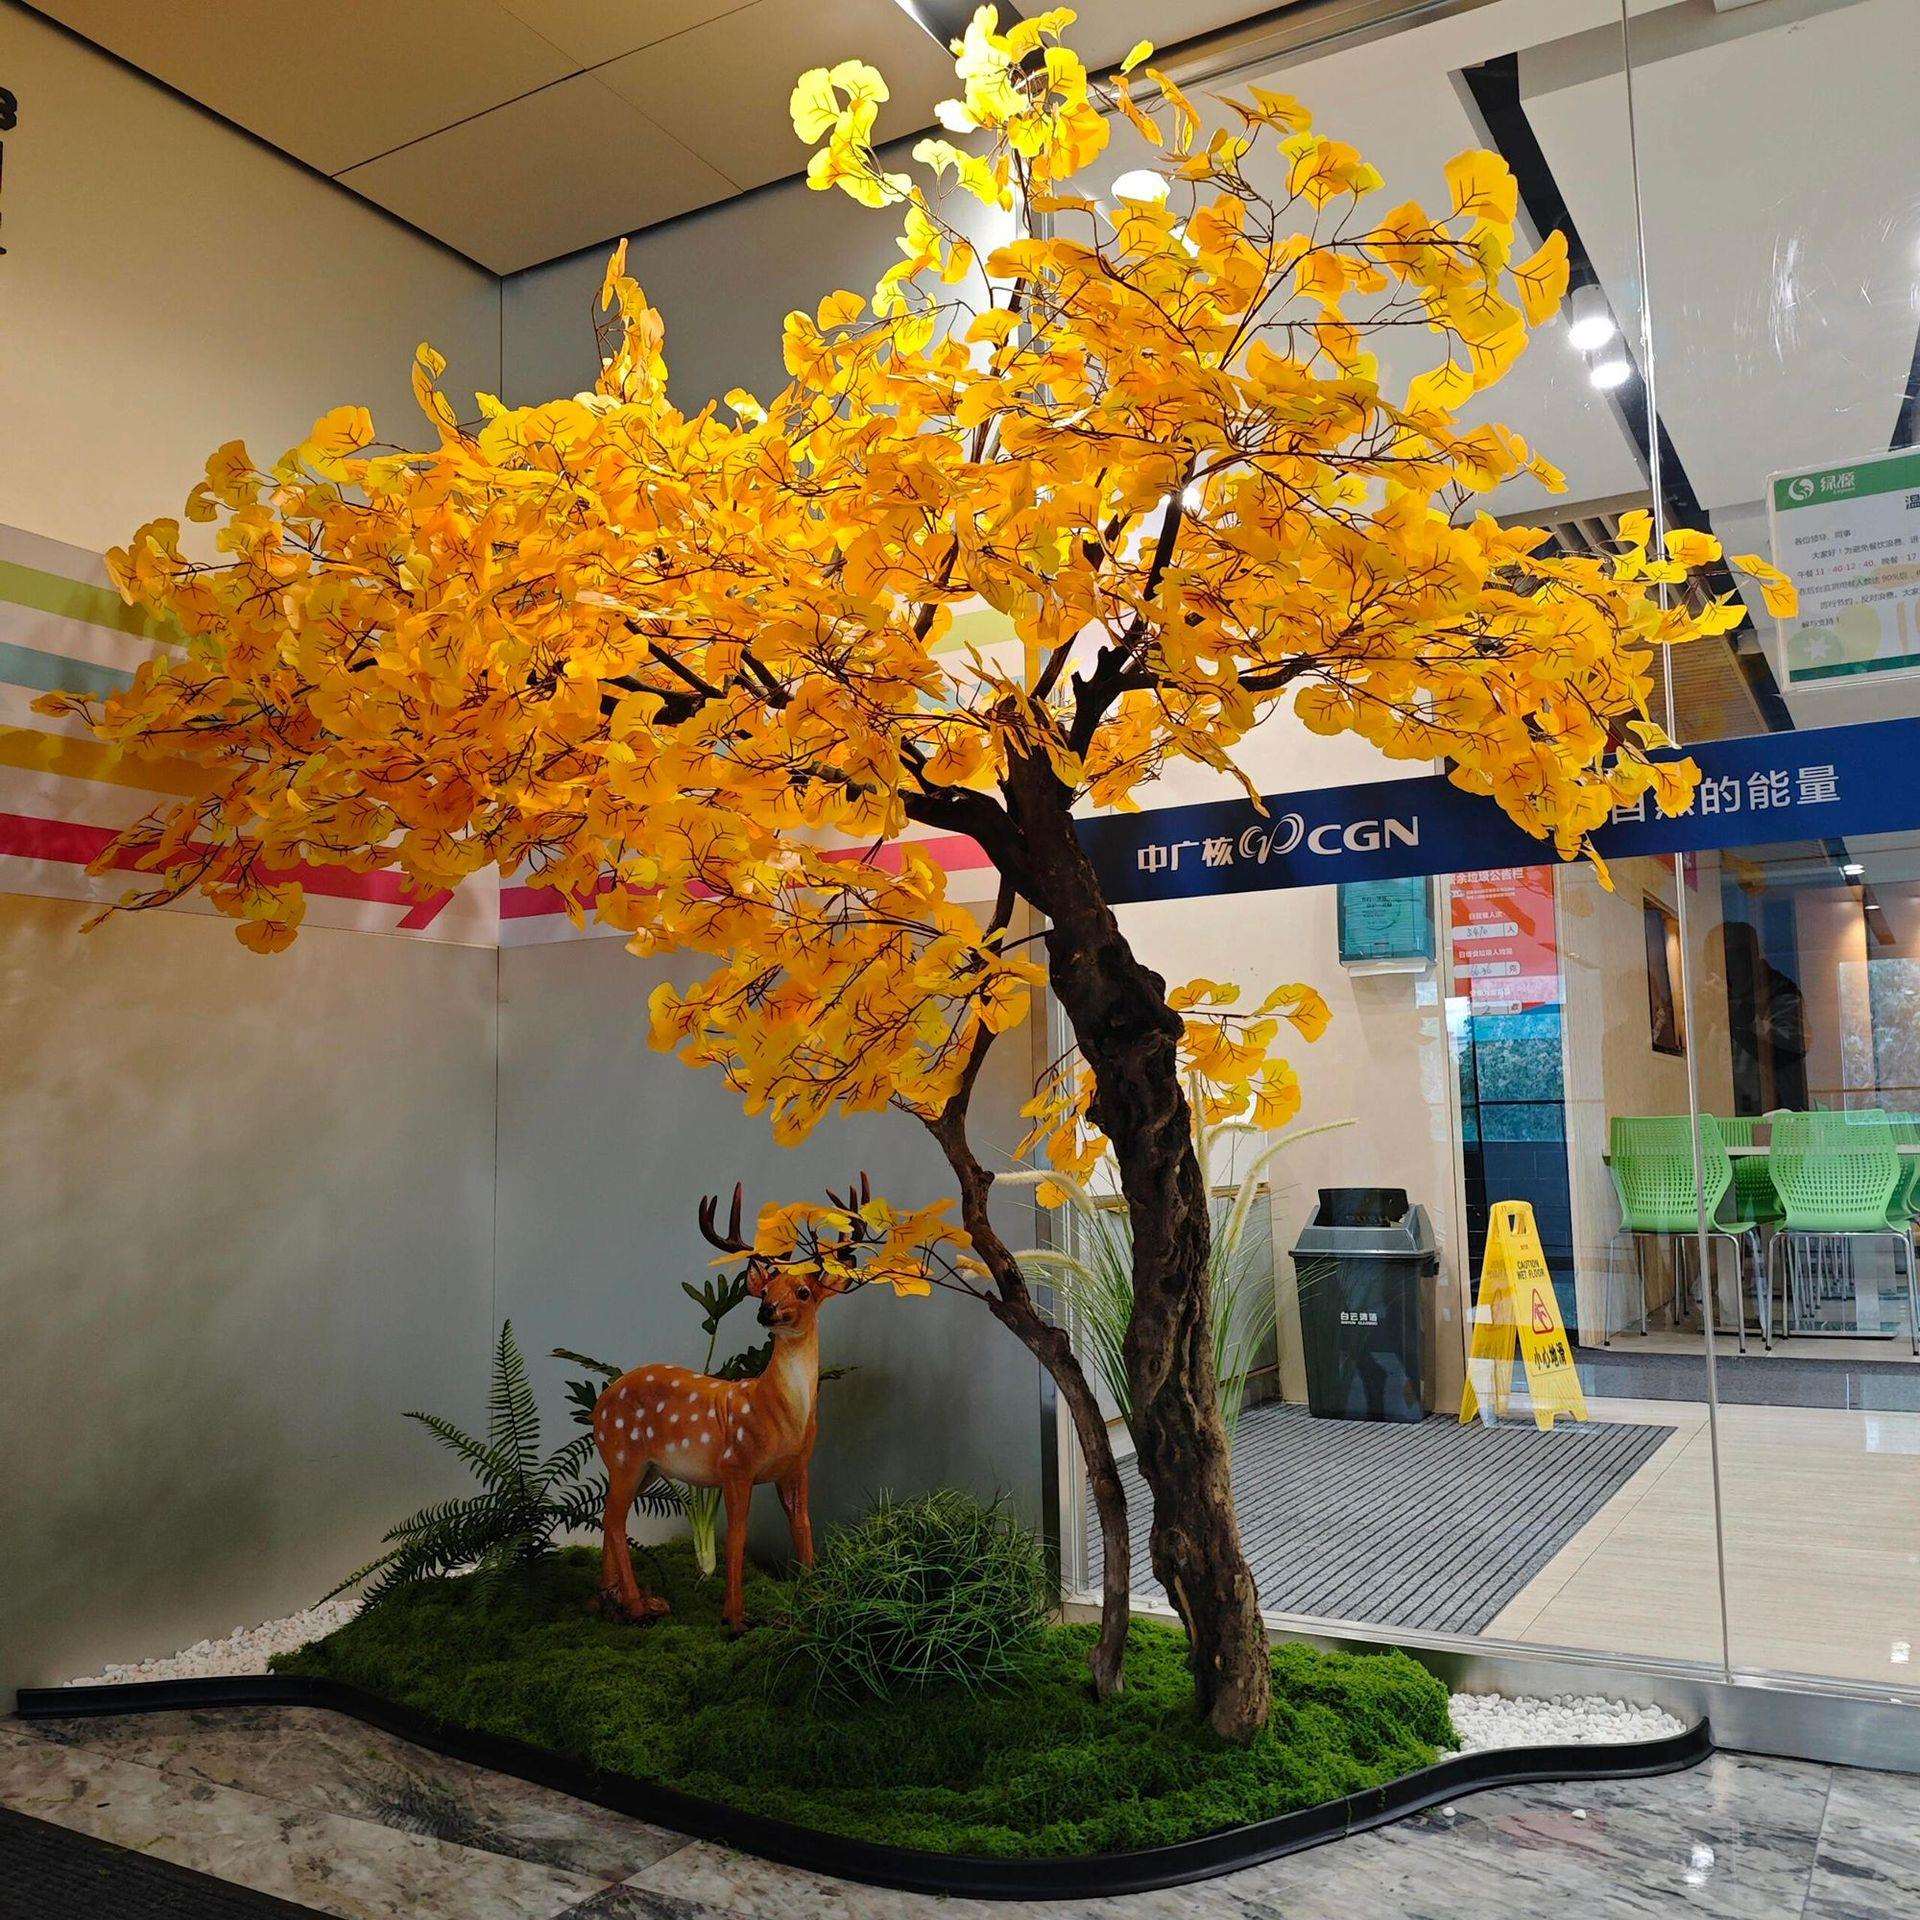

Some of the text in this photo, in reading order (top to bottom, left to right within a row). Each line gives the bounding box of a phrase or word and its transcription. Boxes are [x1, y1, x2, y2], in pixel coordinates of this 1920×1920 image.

[1611, 764, 1841, 825] 自的能量
[1138, 815, 1419, 873] 中广核 CGN
[1516, 1259, 1540, 1270] CAUTION
[1516, 1267, 1544, 1280] WET FLOOR
[1533, 1340, 1567, 1370] 小心地滑
